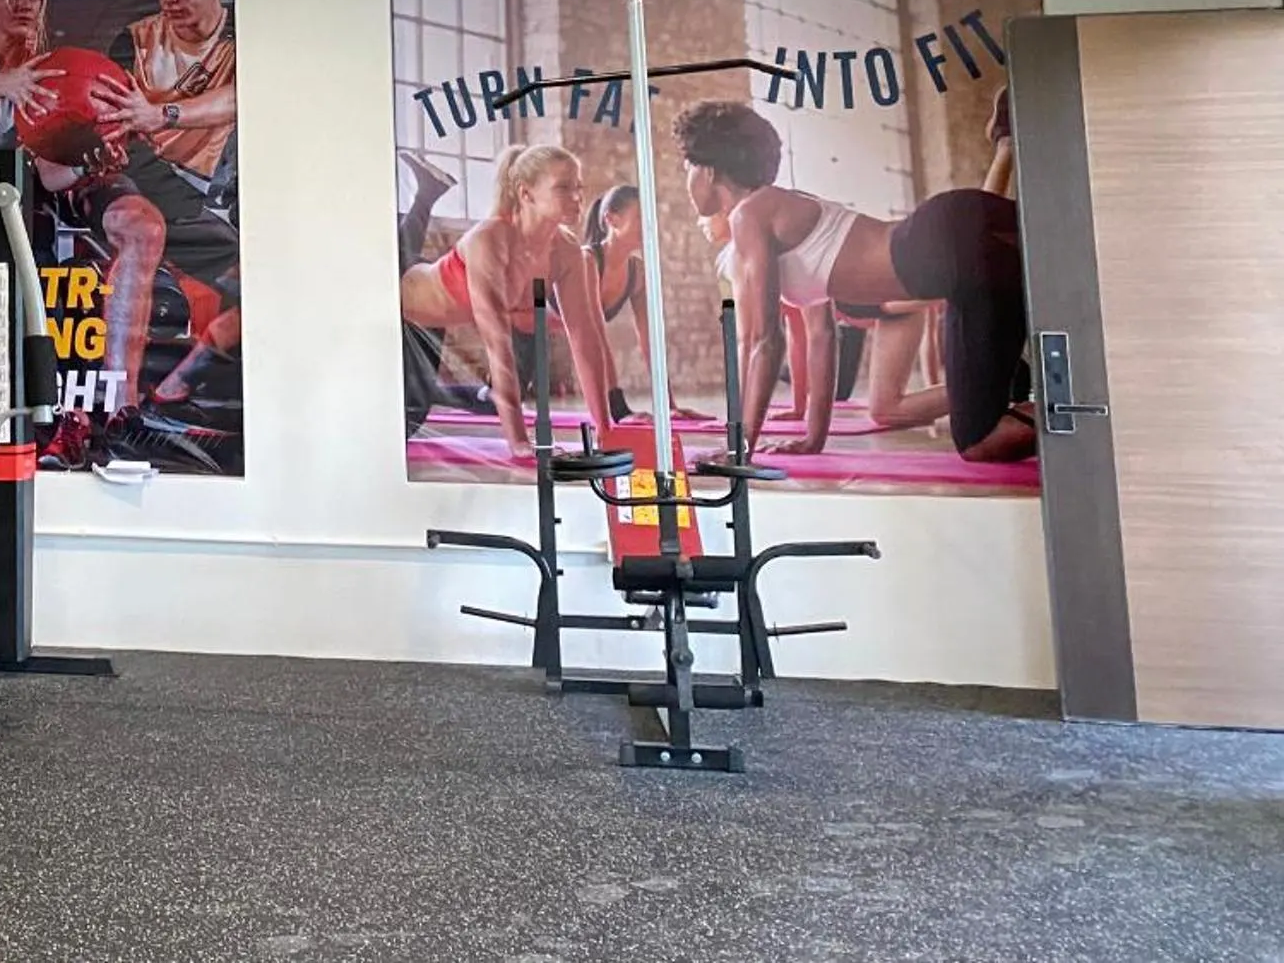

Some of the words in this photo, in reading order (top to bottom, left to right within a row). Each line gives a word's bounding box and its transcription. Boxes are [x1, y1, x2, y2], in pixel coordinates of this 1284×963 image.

[413, 65, 545, 138] TURN
[767, 46, 900, 110] INTO
[914, 8, 1005, 94] FIT
[37, 266, 115, 309] TR-
[46, 316, 108, 360] NG
[56, 369, 128, 414] HT
